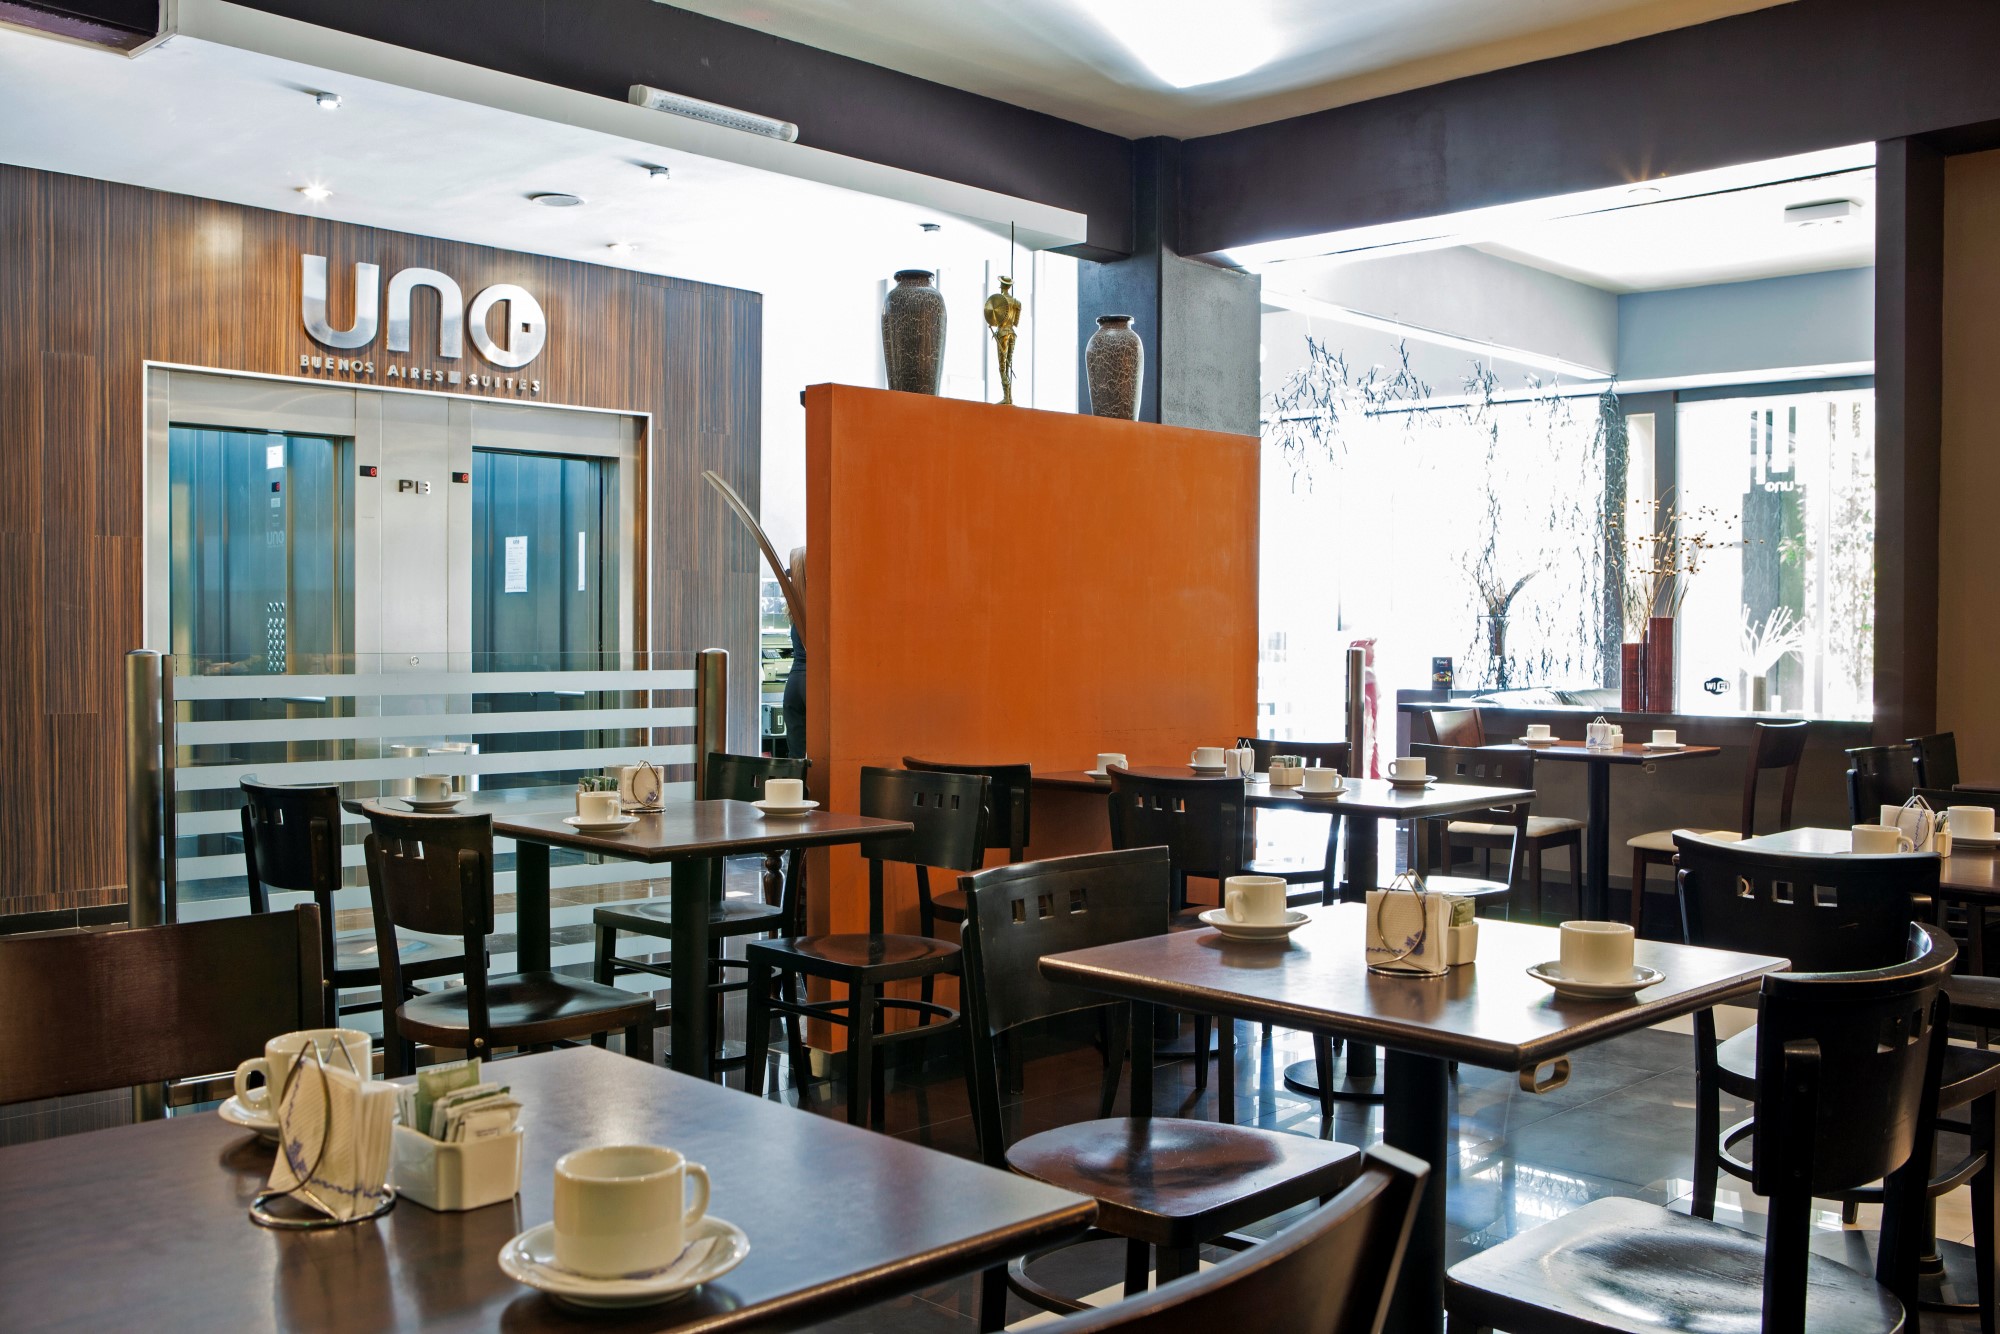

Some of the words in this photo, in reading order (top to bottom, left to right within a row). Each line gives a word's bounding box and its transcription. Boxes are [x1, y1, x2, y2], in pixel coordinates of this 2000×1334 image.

[300, 354, 375, 374] BUENOS
[387, 364, 444, 382] AIRES
[468, 373, 540, 392] SUITES
